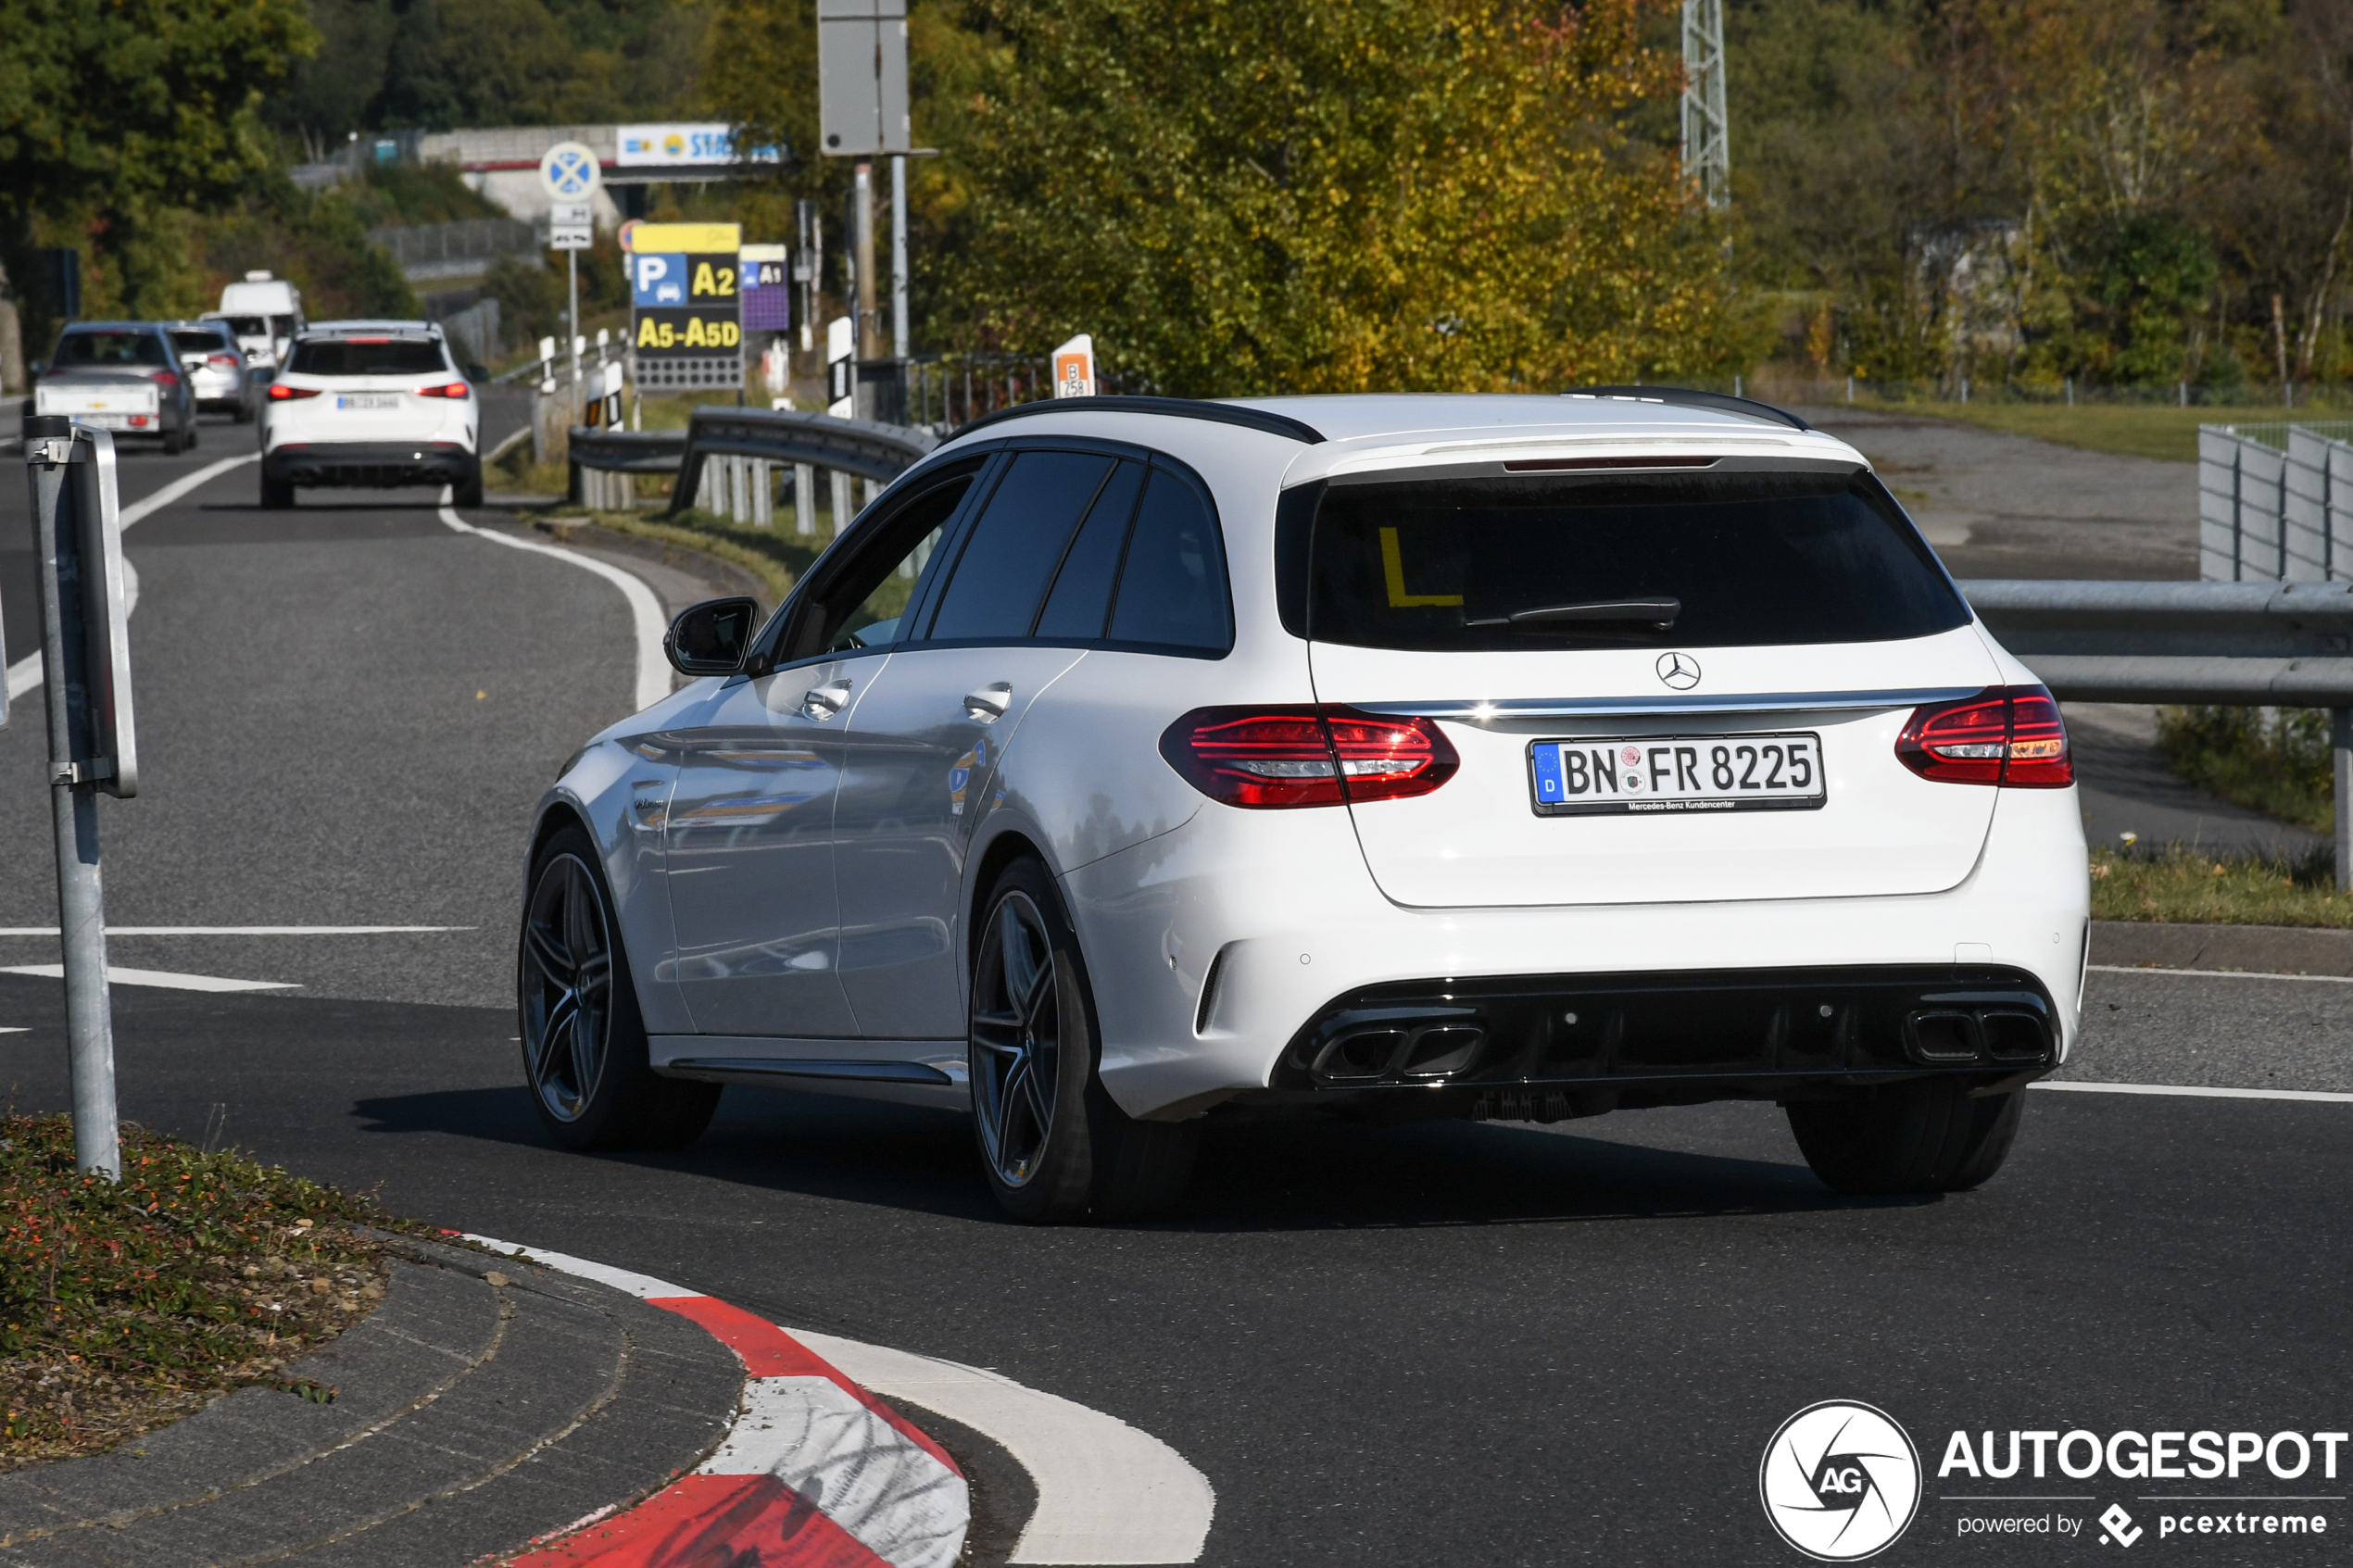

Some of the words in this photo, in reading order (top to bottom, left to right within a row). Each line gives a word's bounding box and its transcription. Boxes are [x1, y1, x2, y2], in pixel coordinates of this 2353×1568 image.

[637, 257, 667, 292] P
[692, 262, 736, 296] A2
[759, 264, 782, 285] A1
[637, 317, 739, 348] A5-A5D
[1068, 365, 1077, 380] B
[1064, 381, 1084, 396] 258
[1564, 748, 1619, 795] BN
[1647, 746, 1702, 792] FR
[1711, 744, 1812, 790] 8225
[1545, 779, 1556, 794] D
[1628, 801, 1684, 811] Mercedes-Benz
[1685, 799, 1736, 809] Kundencenter
